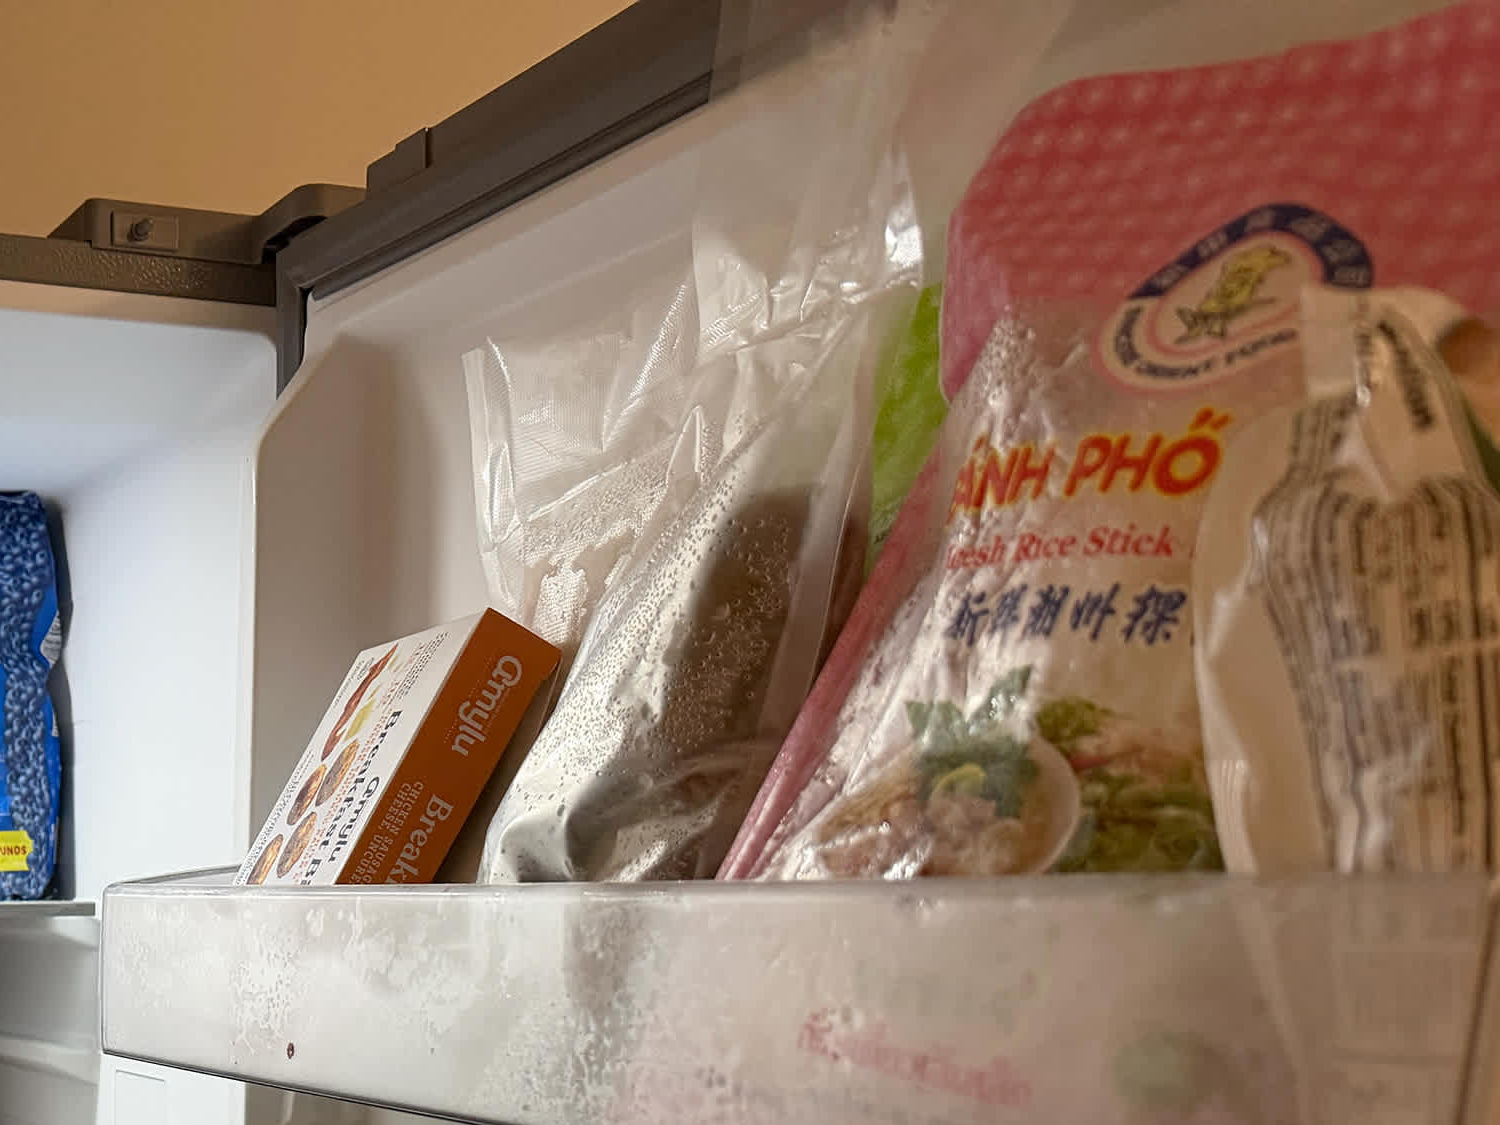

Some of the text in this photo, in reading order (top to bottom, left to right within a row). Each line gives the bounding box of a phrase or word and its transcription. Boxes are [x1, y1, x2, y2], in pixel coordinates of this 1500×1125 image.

[945, 434, 1058, 528] ÁNH
[1015, 531, 1077, 563] Rice
[1083, 522, 1173, 557] Stick
[319, 710, 403, 848] Breakfast
[351, 782, 412, 884] CHEESE, UNCURE
[362, 782, 424, 884] CHICKEN SAUSAG
[386, 794, 453, 884] Break
